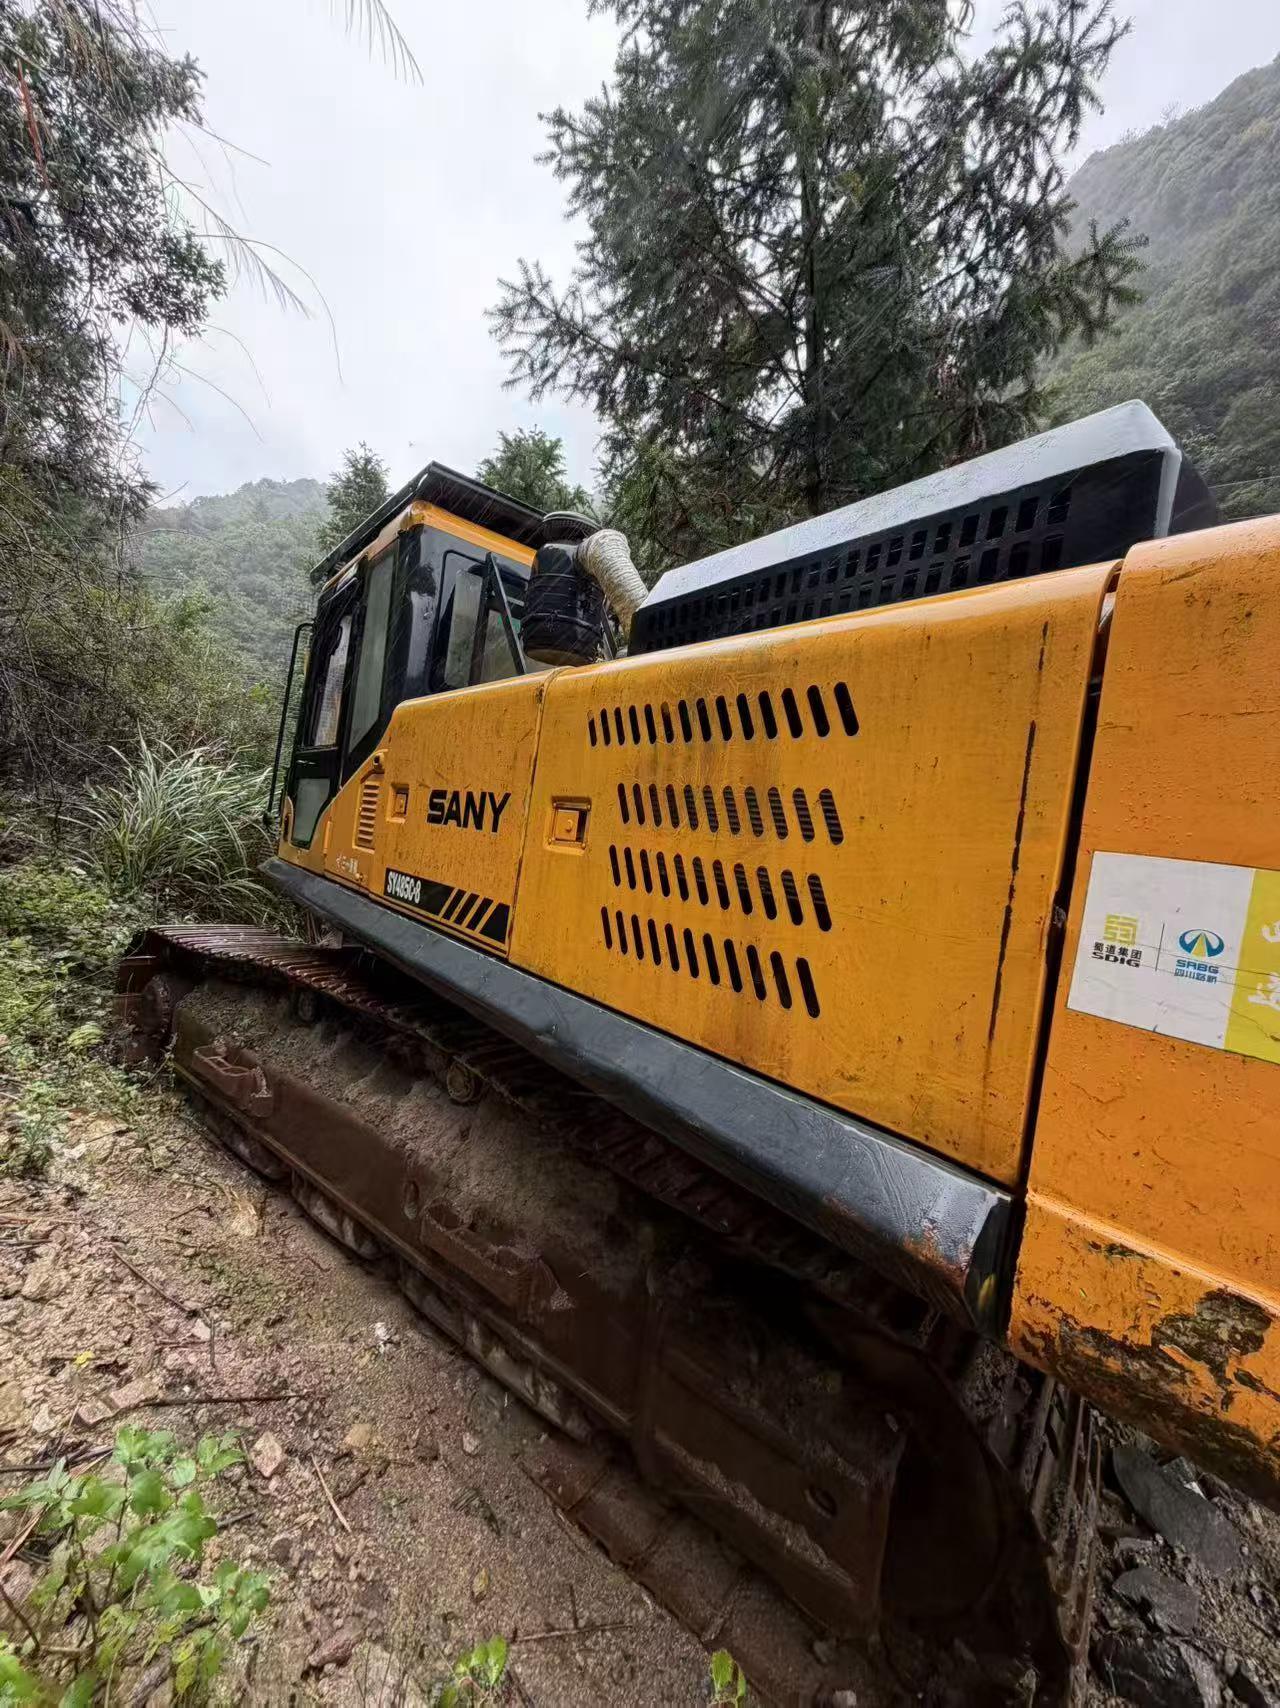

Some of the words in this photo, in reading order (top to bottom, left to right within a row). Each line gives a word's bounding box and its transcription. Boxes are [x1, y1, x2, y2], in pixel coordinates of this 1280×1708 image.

[427, 789, 512, 833] SANY
[1094, 942, 1143, 959] 蜀道集团
[1091, 951, 1141, 968] SDIG
[1175, 959, 1219, 974] SRBG
